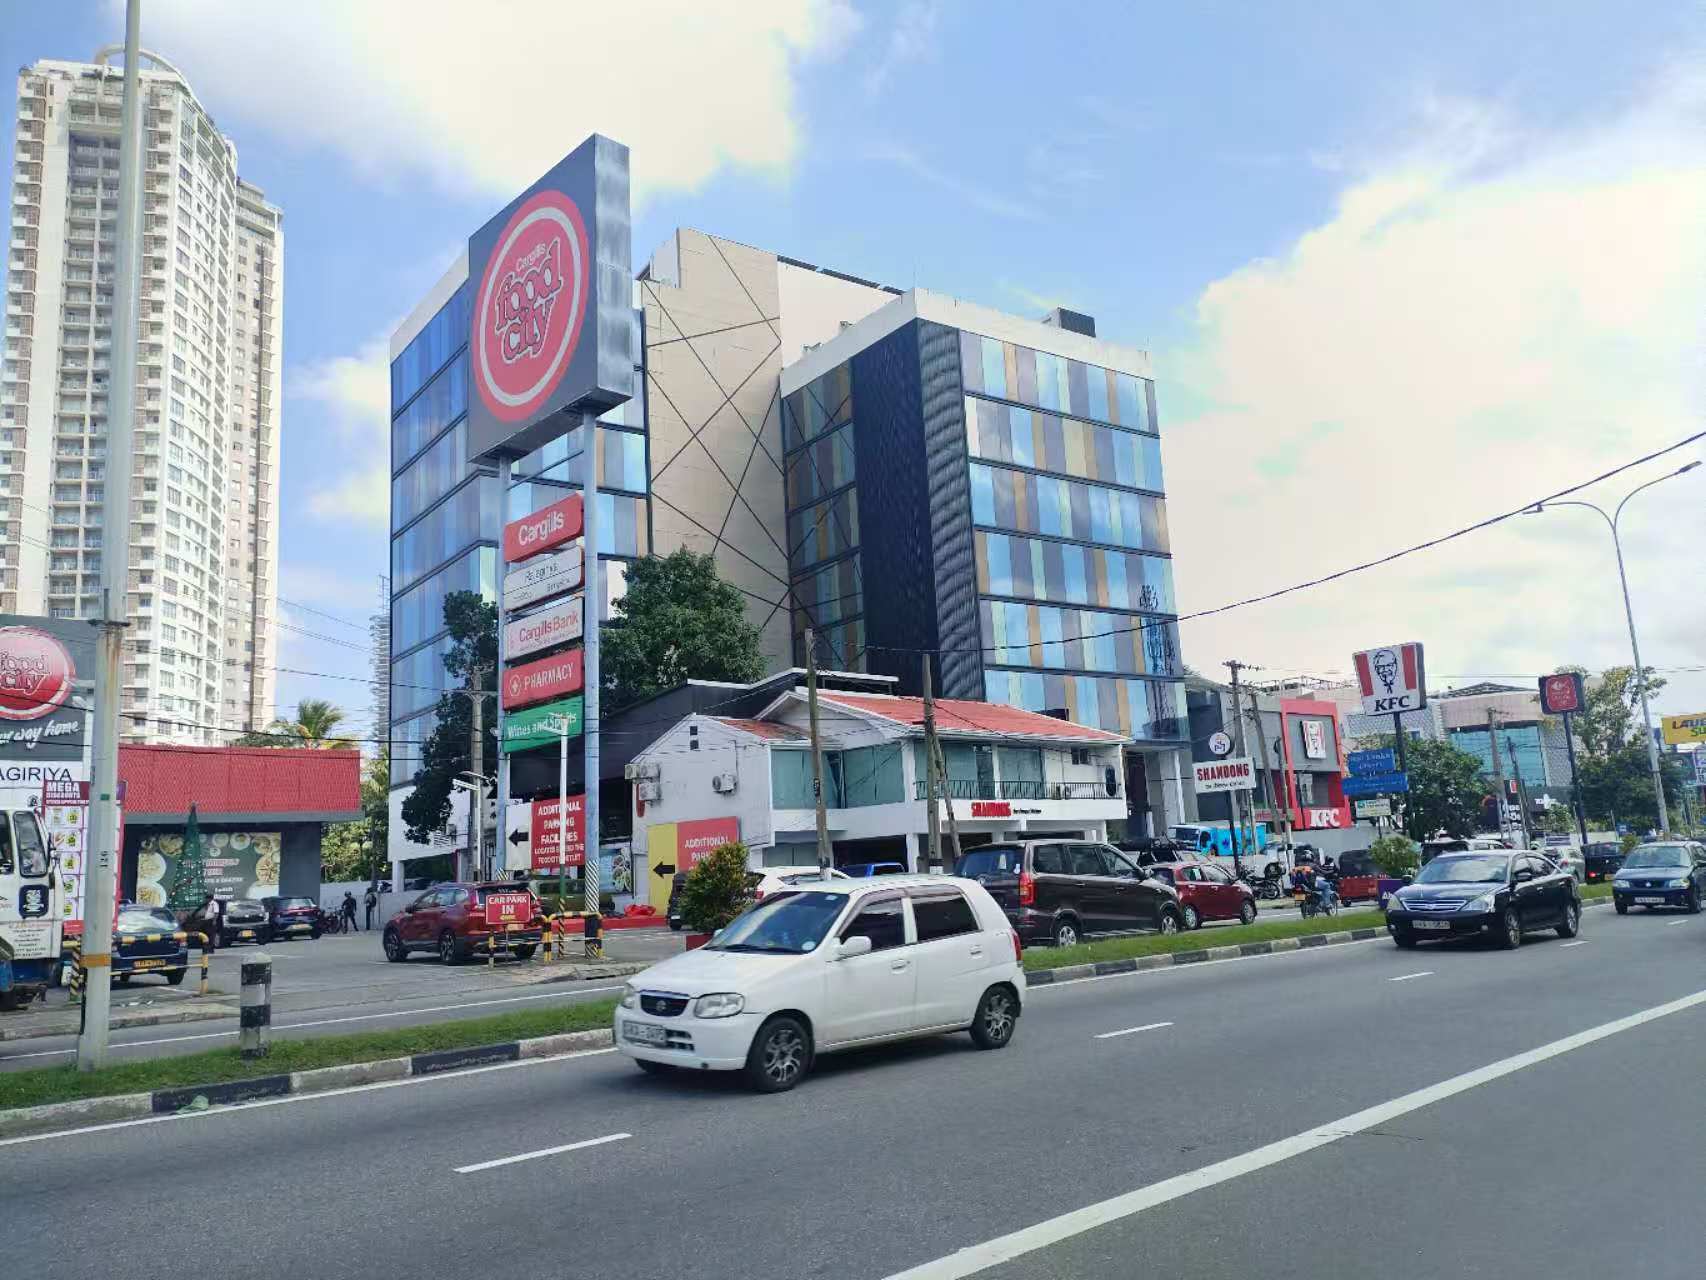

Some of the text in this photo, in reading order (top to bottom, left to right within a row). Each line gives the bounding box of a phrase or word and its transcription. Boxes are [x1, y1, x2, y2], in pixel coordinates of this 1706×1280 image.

[495, 236, 563, 335] food
[518, 510, 565, 546] Cargills
[523, 662, 574, 690] PHARMACY
[1375, 696, 1410, 712] KFC
[14, 728, 43, 749] way
[44, 720, 79, 737] home
[508, 724, 531, 738] Wines
[1197, 763, 1250, 782] SHANDONG
[46, 782, 81, 792] MEGA
[971, 801, 1012, 817] SHANDONG
[1310, 809, 1340, 828] KFC
[685, 836, 729, 848] ADDITIONAL
[506, 895, 527, 904] PARK
[502, 904, 515, 914] IN
